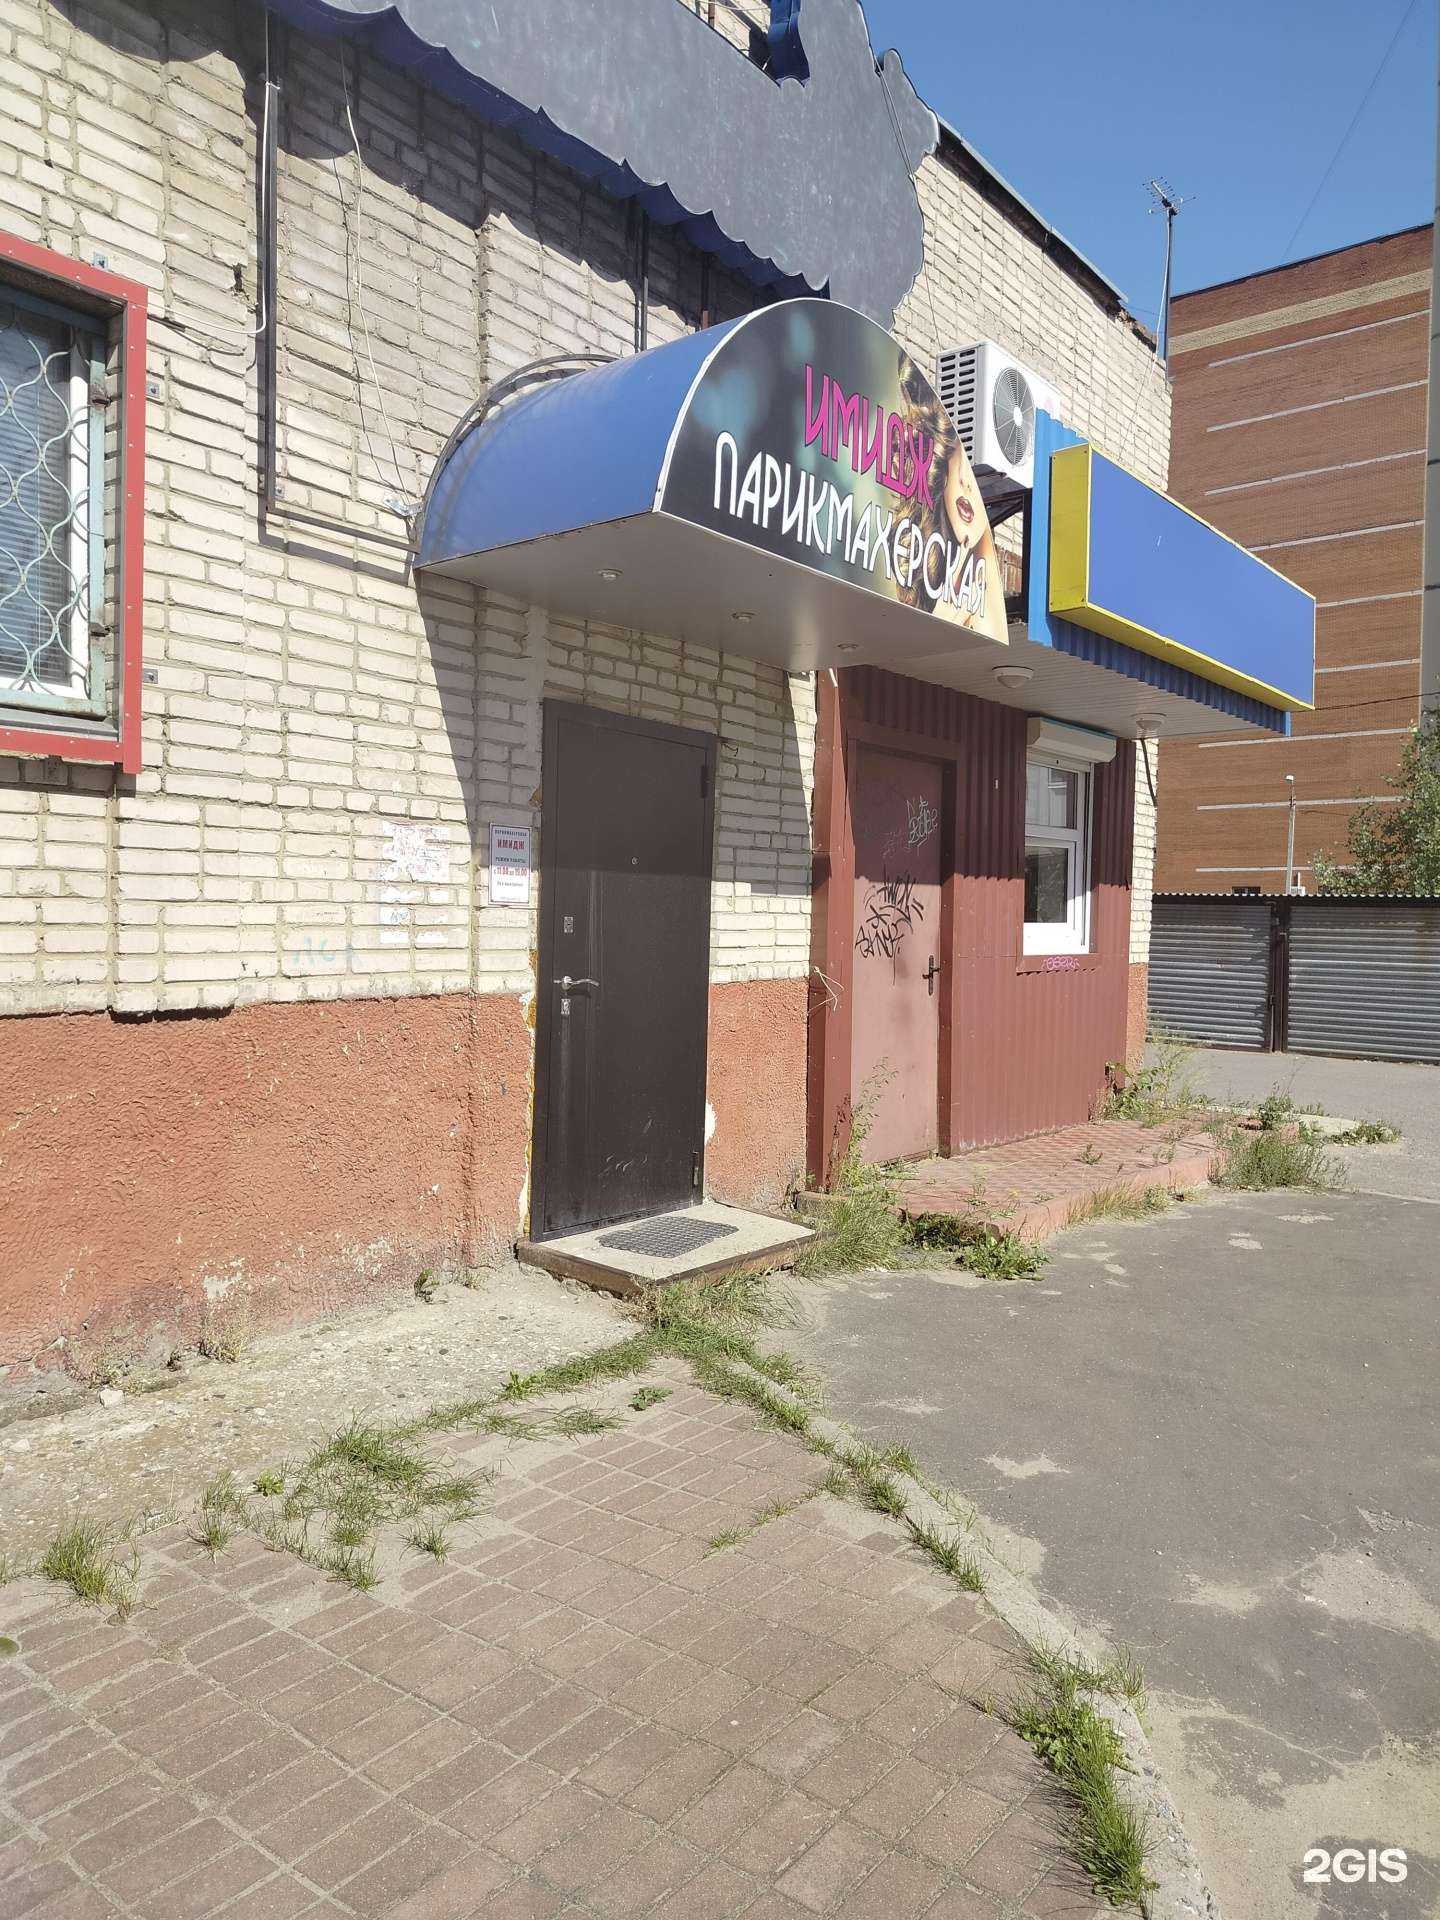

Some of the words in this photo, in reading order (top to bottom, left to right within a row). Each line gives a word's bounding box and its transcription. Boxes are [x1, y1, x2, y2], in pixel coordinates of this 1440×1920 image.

[804, 363, 935, 510] ИМИДЖ
[713, 431, 987, 618] ПАРИКМАХЕРСКАЯ
[497, 839, 524, 850] ИМИДЖ
